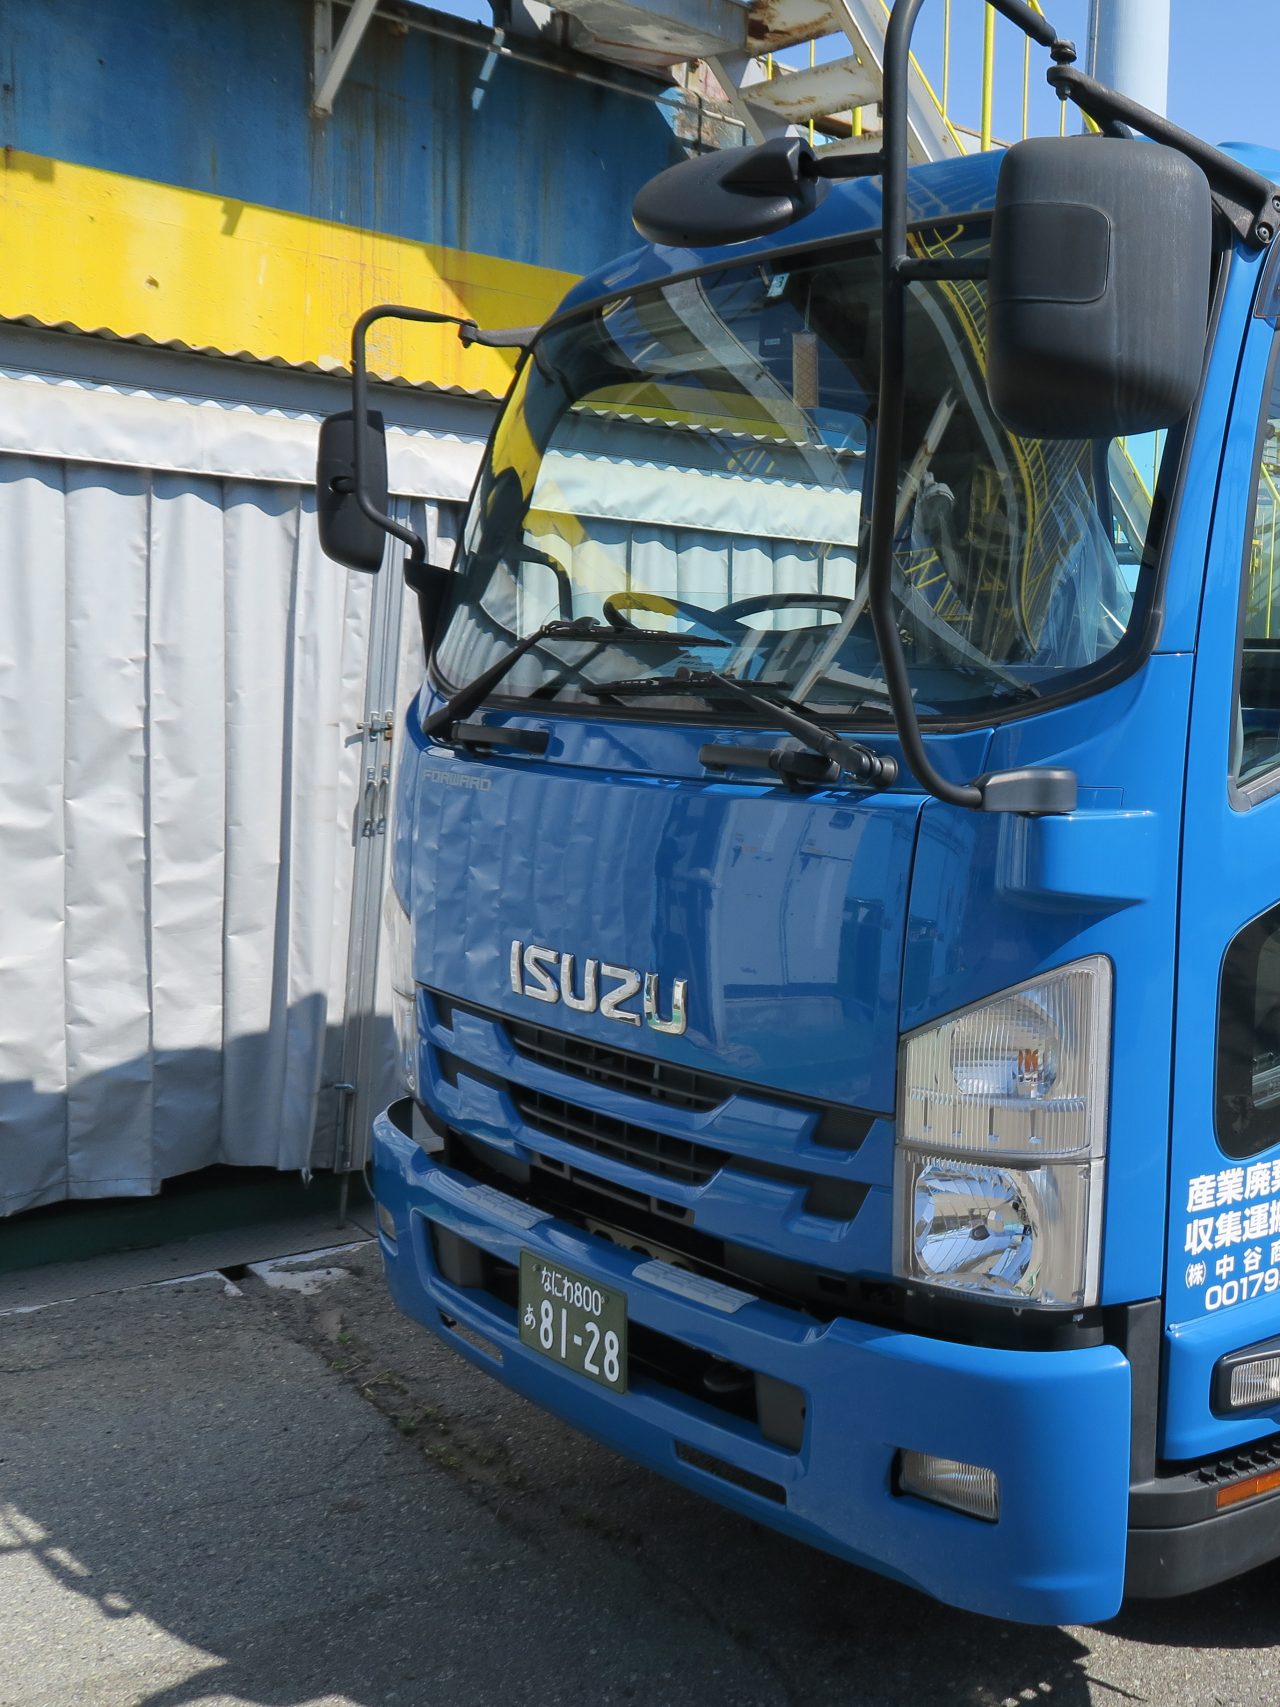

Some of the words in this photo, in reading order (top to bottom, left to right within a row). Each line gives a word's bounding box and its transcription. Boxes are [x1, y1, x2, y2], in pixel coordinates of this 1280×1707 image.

[422, 767, 492, 793] FORWARD
[510, 939, 688, 1036] ISUZU
[524, 1303, 536, 1331] あ
[540, 1299, 620, 1383] 81-28
